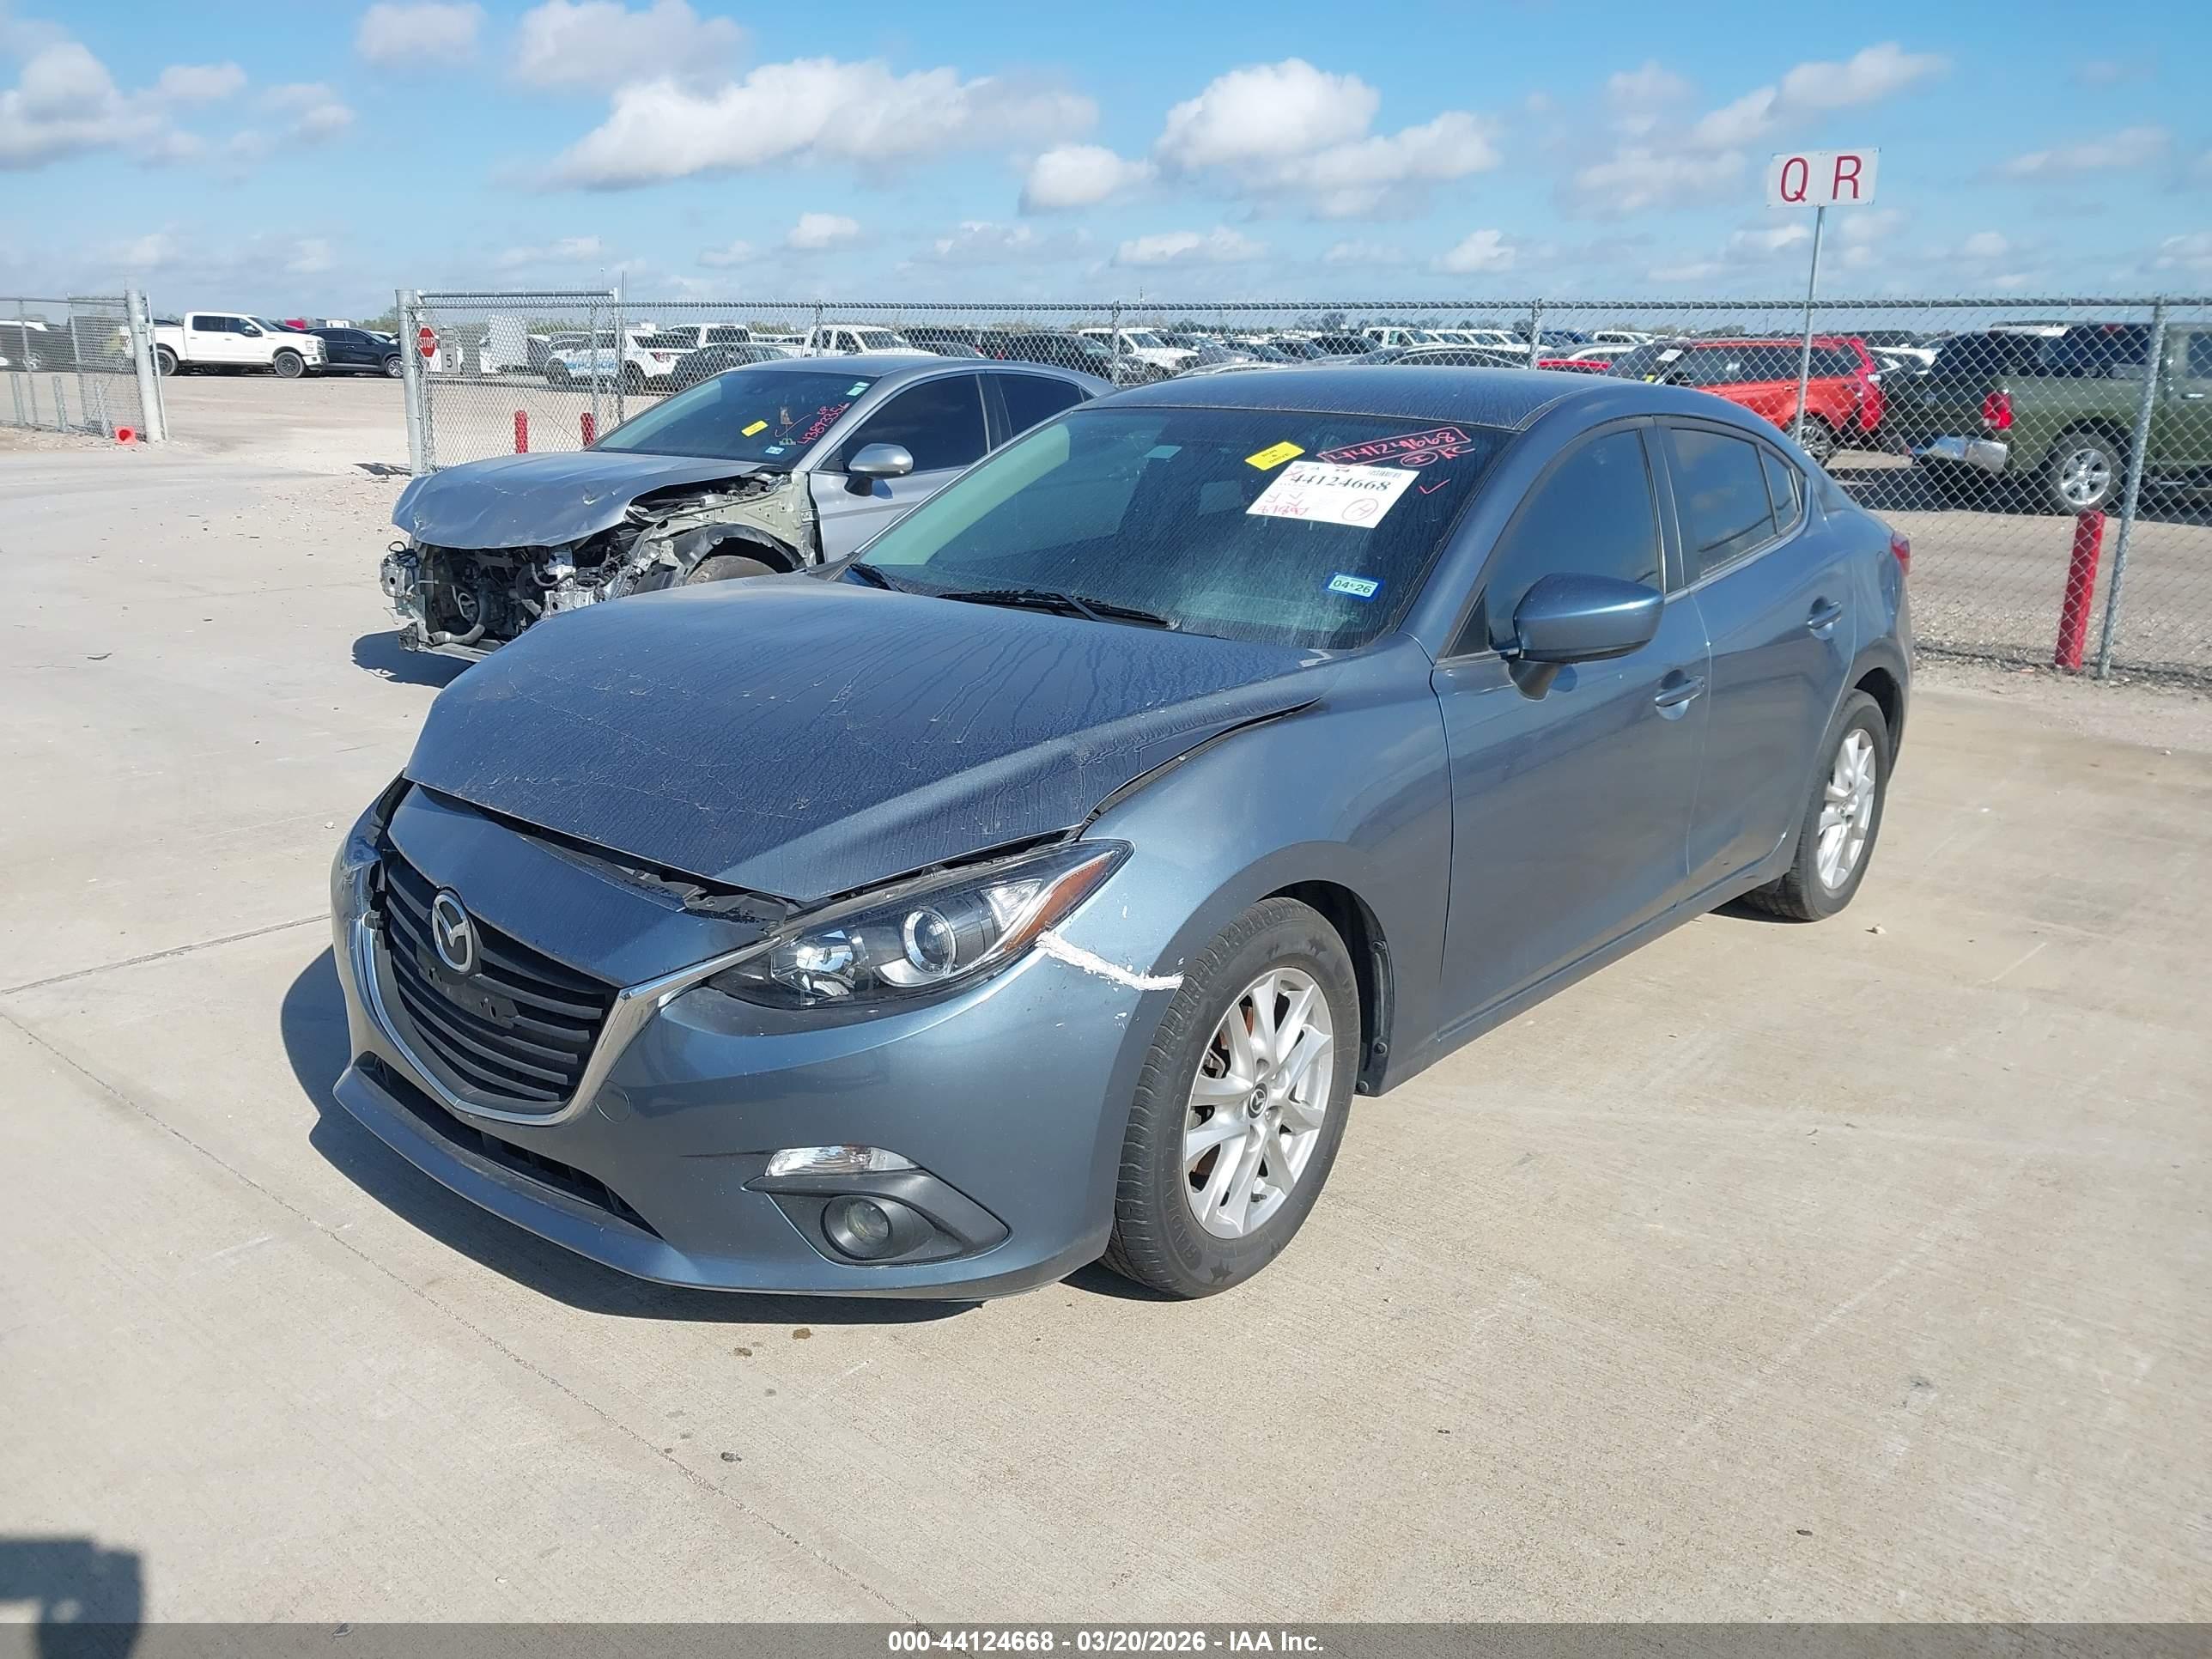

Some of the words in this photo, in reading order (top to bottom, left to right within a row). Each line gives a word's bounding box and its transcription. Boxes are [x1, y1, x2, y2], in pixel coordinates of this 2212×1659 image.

[1780, 157, 1809, 203] Q
[1832, 155, 1862, 200] R
[420, 337, 434, 349] STOP
[446, 354, 453, 368] 5
[1290, 473, 1391, 492] 44124668
[1334, 580, 1350, 588] 04
[1355, 584, 1372, 593] 26
